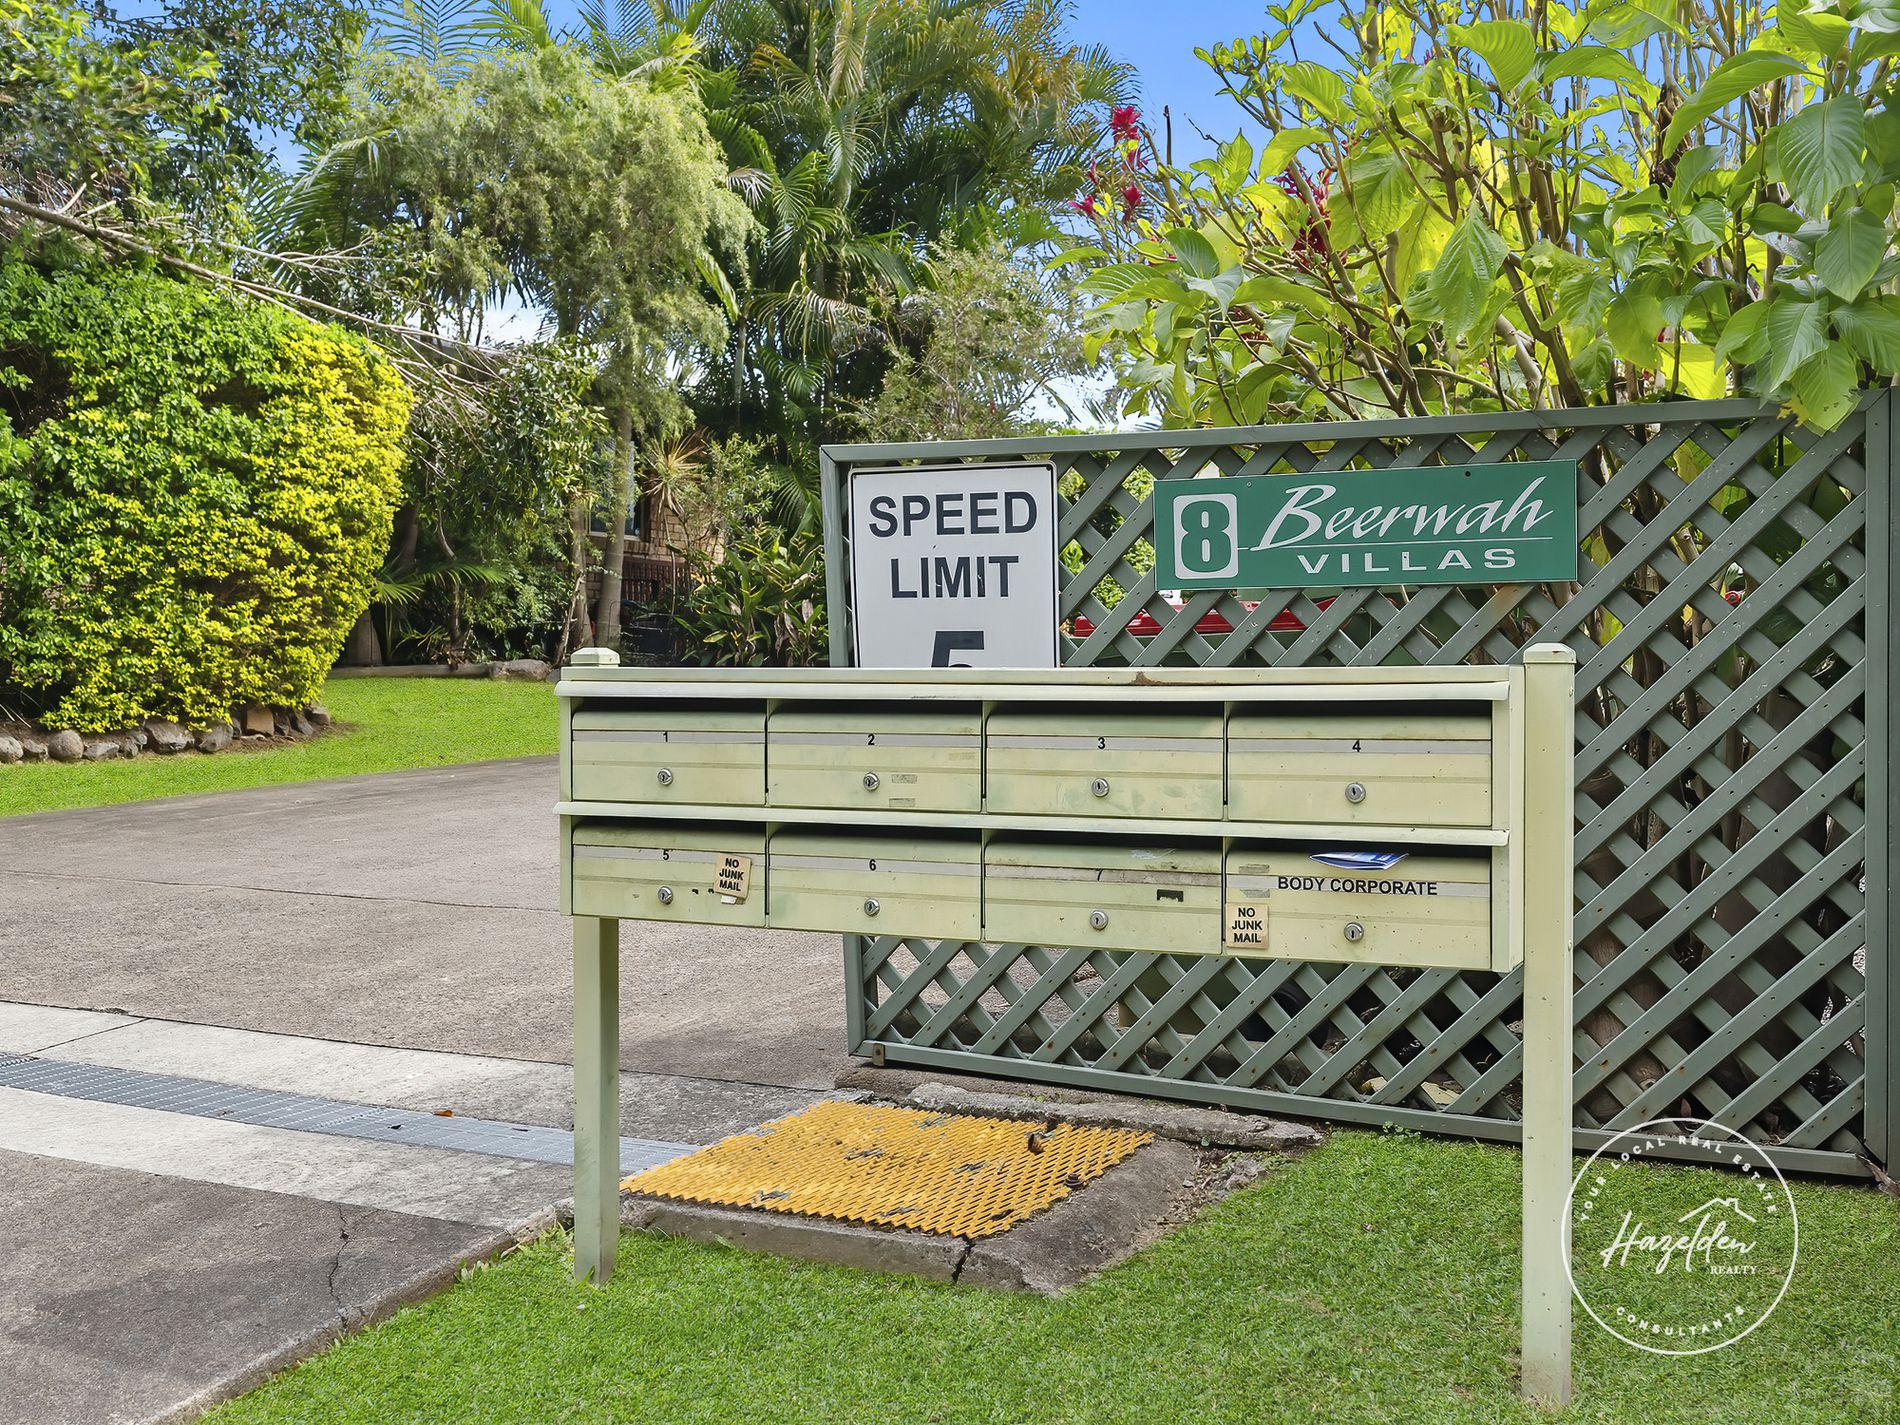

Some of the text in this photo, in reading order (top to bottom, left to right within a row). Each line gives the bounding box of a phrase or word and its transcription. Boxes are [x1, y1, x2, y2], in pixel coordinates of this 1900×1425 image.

[868, 491, 1038, 538] SPEED
[1249, 475, 1554, 551] Beerwah
[1180, 499, 1231, 574] 8
[1297, 547, 1517, 574] VILLAS
[890, 555, 1020, 598] LIMIT
[662, 730, 668, 743] 1
[866, 732, 875, 746] 2
[1097, 736, 1106, 750] 3
[1352, 739, 1361, 753] 4
[662, 848, 670, 861] 5
[725, 858, 740, 868] NO
[869, 858, 877, 872] 6
[719, 868, 744, 880] JUNK
[719, 879, 741, 892] MAIL
[1278, 876, 1437, 895] BODY CORPORATE
[1238, 907, 1256, 918] NO
[1232, 920, 1263, 931] JUNK
[1233, 932, 1262, 943] MAIL
